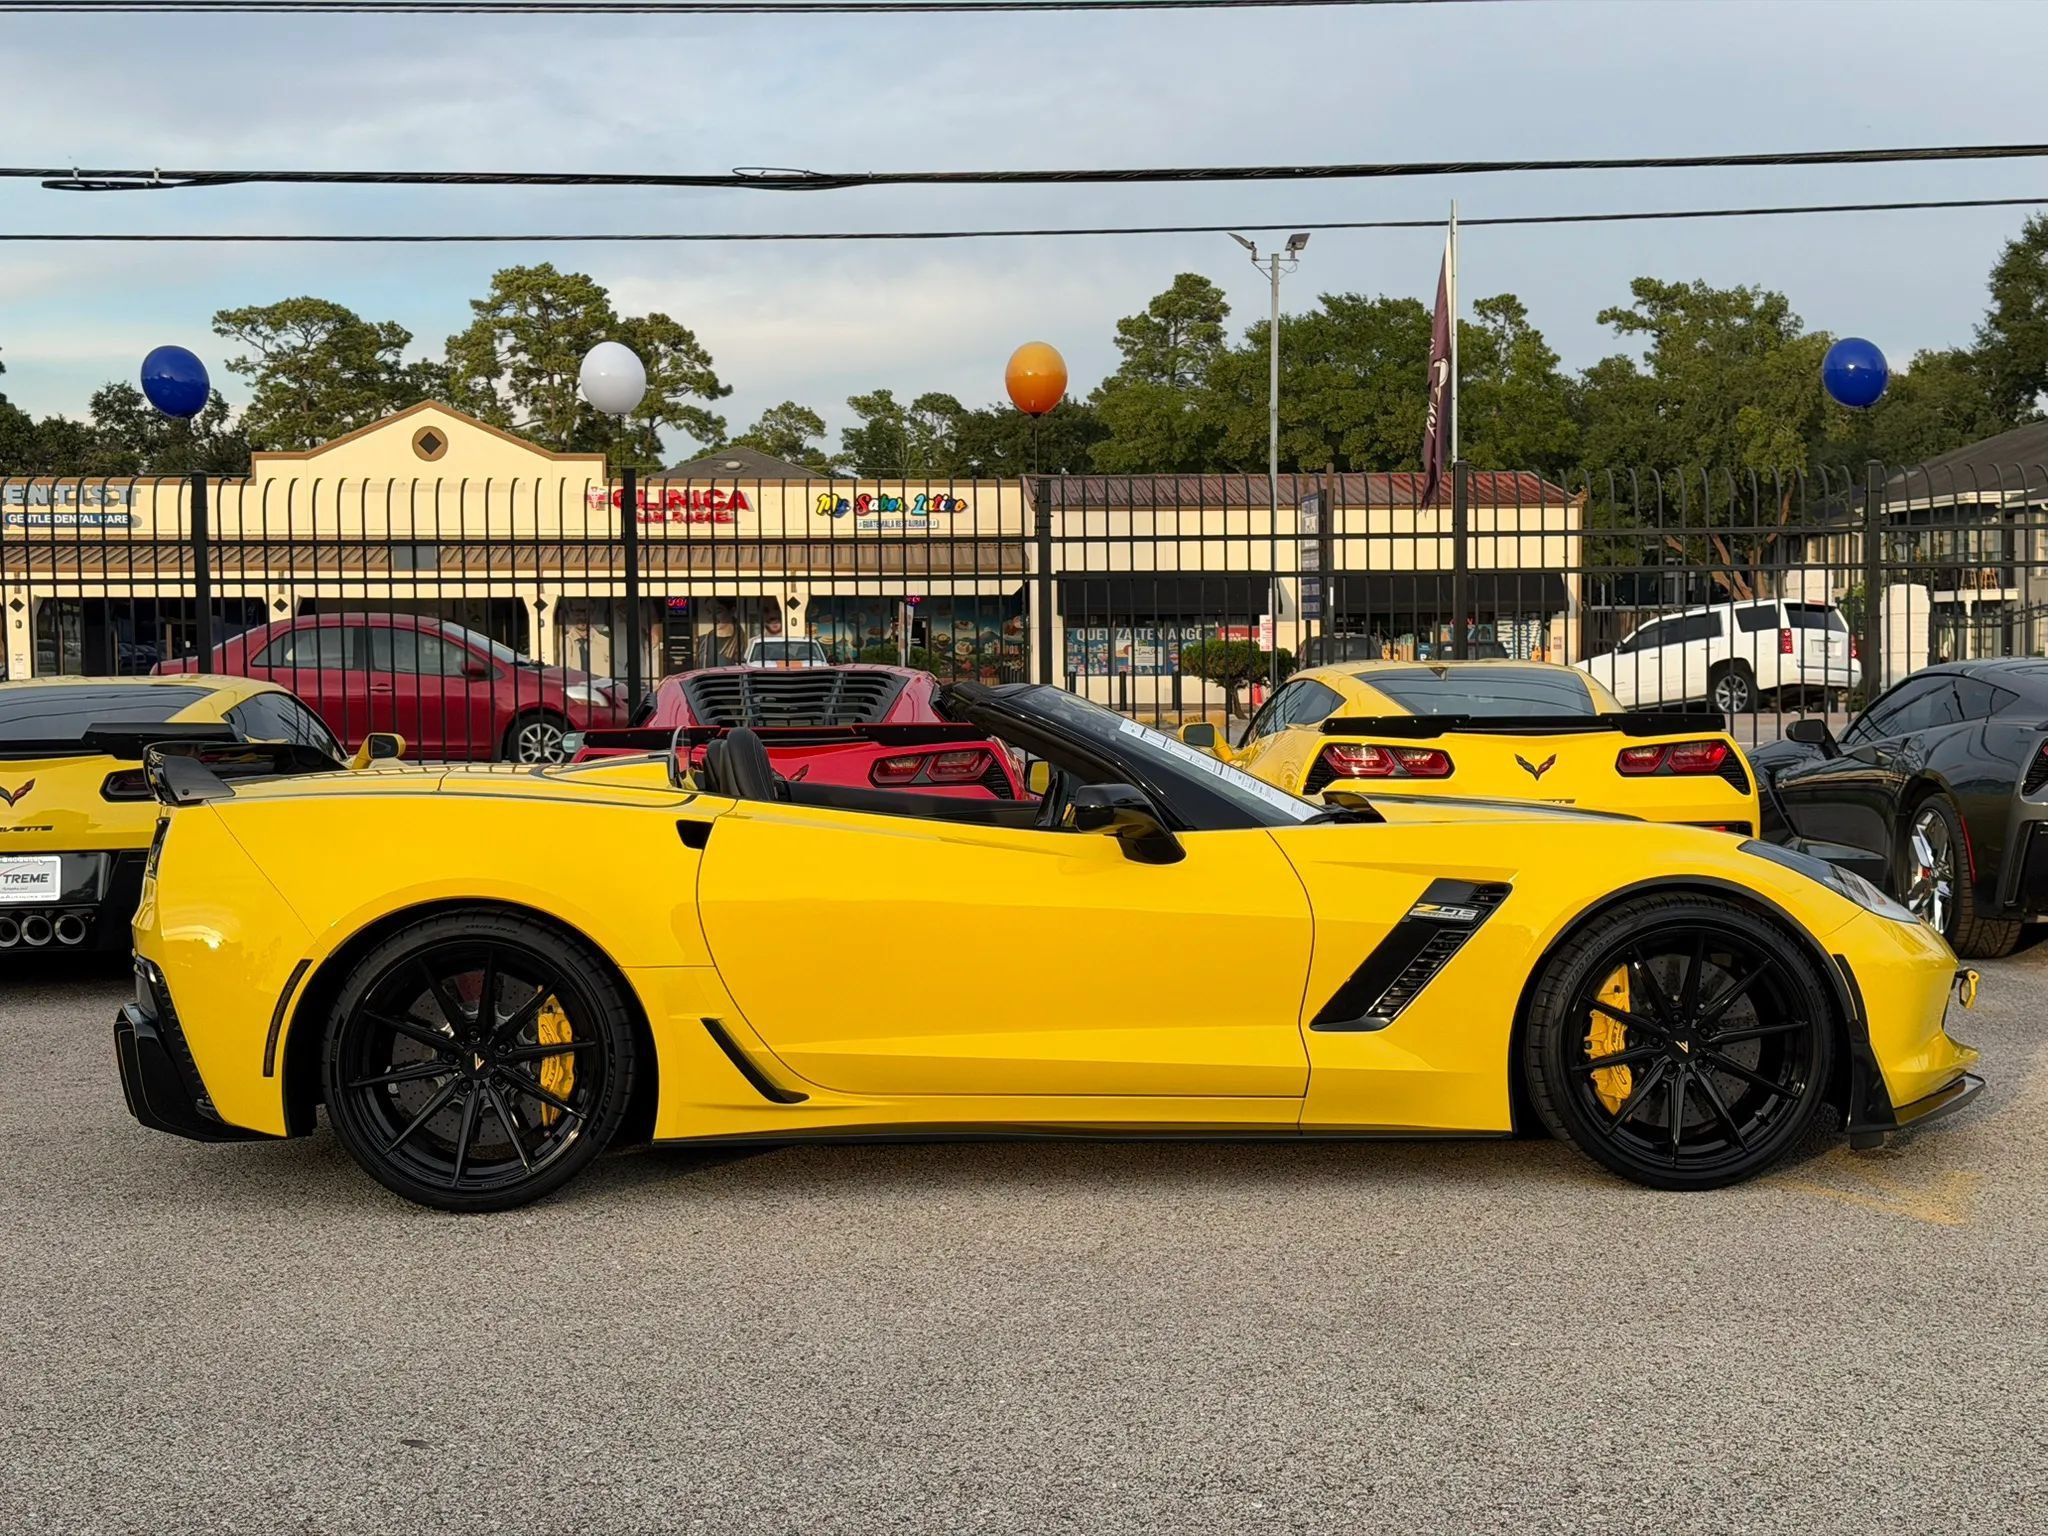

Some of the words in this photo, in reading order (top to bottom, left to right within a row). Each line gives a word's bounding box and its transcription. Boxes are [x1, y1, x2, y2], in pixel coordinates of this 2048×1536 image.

[911, 493, 968, 516] Latino
[54, 514, 97, 524] DENTAL
[99, 514, 129, 524] CARE
